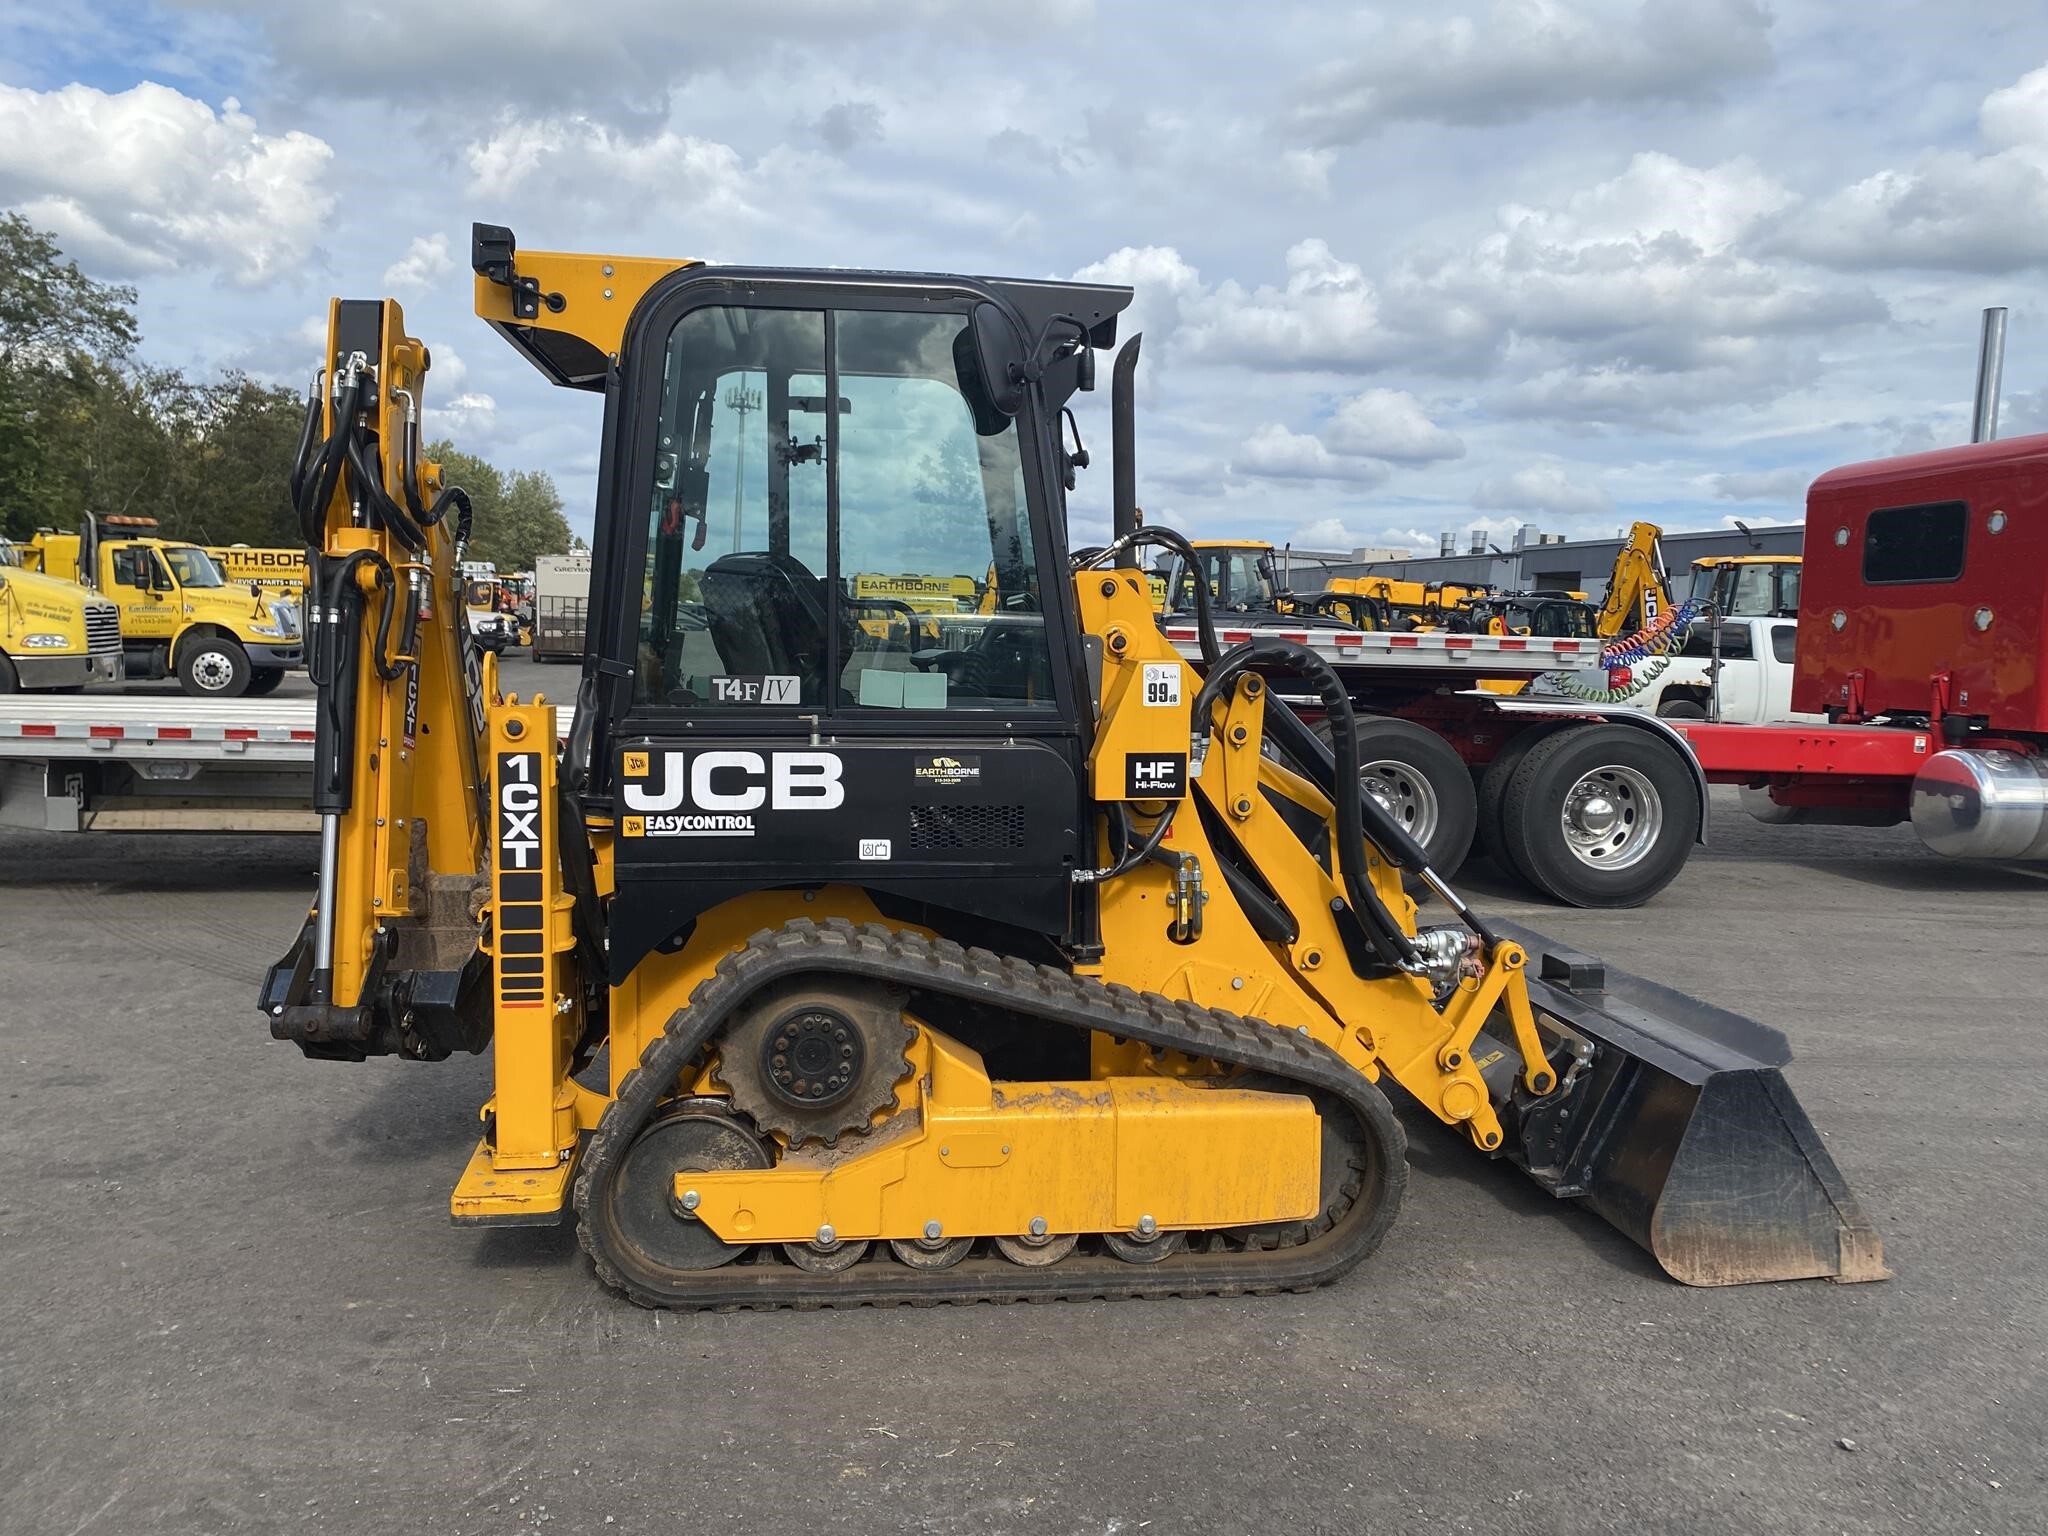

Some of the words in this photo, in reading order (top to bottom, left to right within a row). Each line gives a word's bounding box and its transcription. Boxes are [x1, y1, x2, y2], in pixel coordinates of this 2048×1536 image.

[263, 579, 285, 587] PARTS
[861, 581, 949, 592] EARTHBORNE
[1148, 683, 1168, 702] 99
[1135, 762, 1175, 779] HF
[624, 751, 845, 811] JCB
[1135, 781, 1176, 789] Hi-Flow
[501, 754, 539, 868] 1CXT
